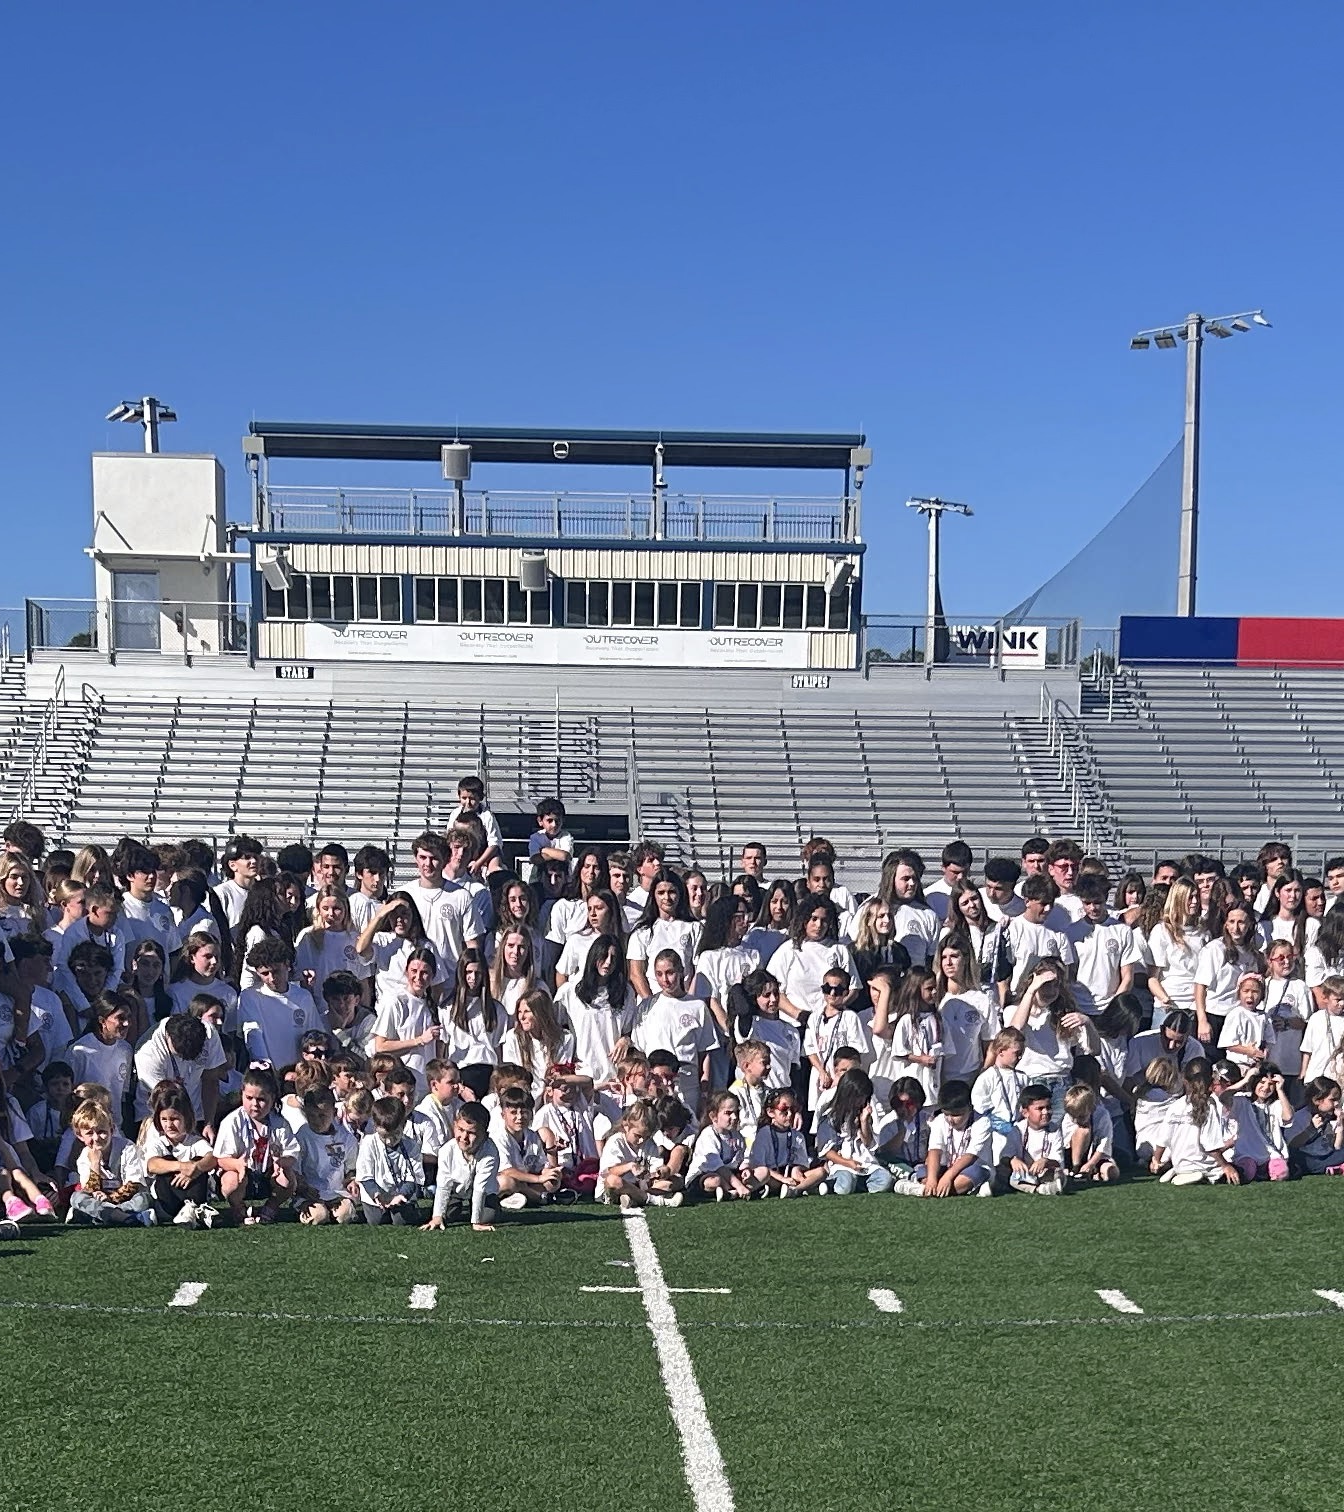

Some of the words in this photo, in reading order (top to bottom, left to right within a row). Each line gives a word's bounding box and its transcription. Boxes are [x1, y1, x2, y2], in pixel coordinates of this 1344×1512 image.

[332, 629, 408, 639] OUTRECOVER
[457, 631, 534, 642] OUTRECOVER
[583, 635, 659, 645] OUTRECOVER
[707, 637, 784, 647] OUTRECOVER
[956, 630, 1039, 650] WINK
[792, 675, 828, 688] STRIPES
